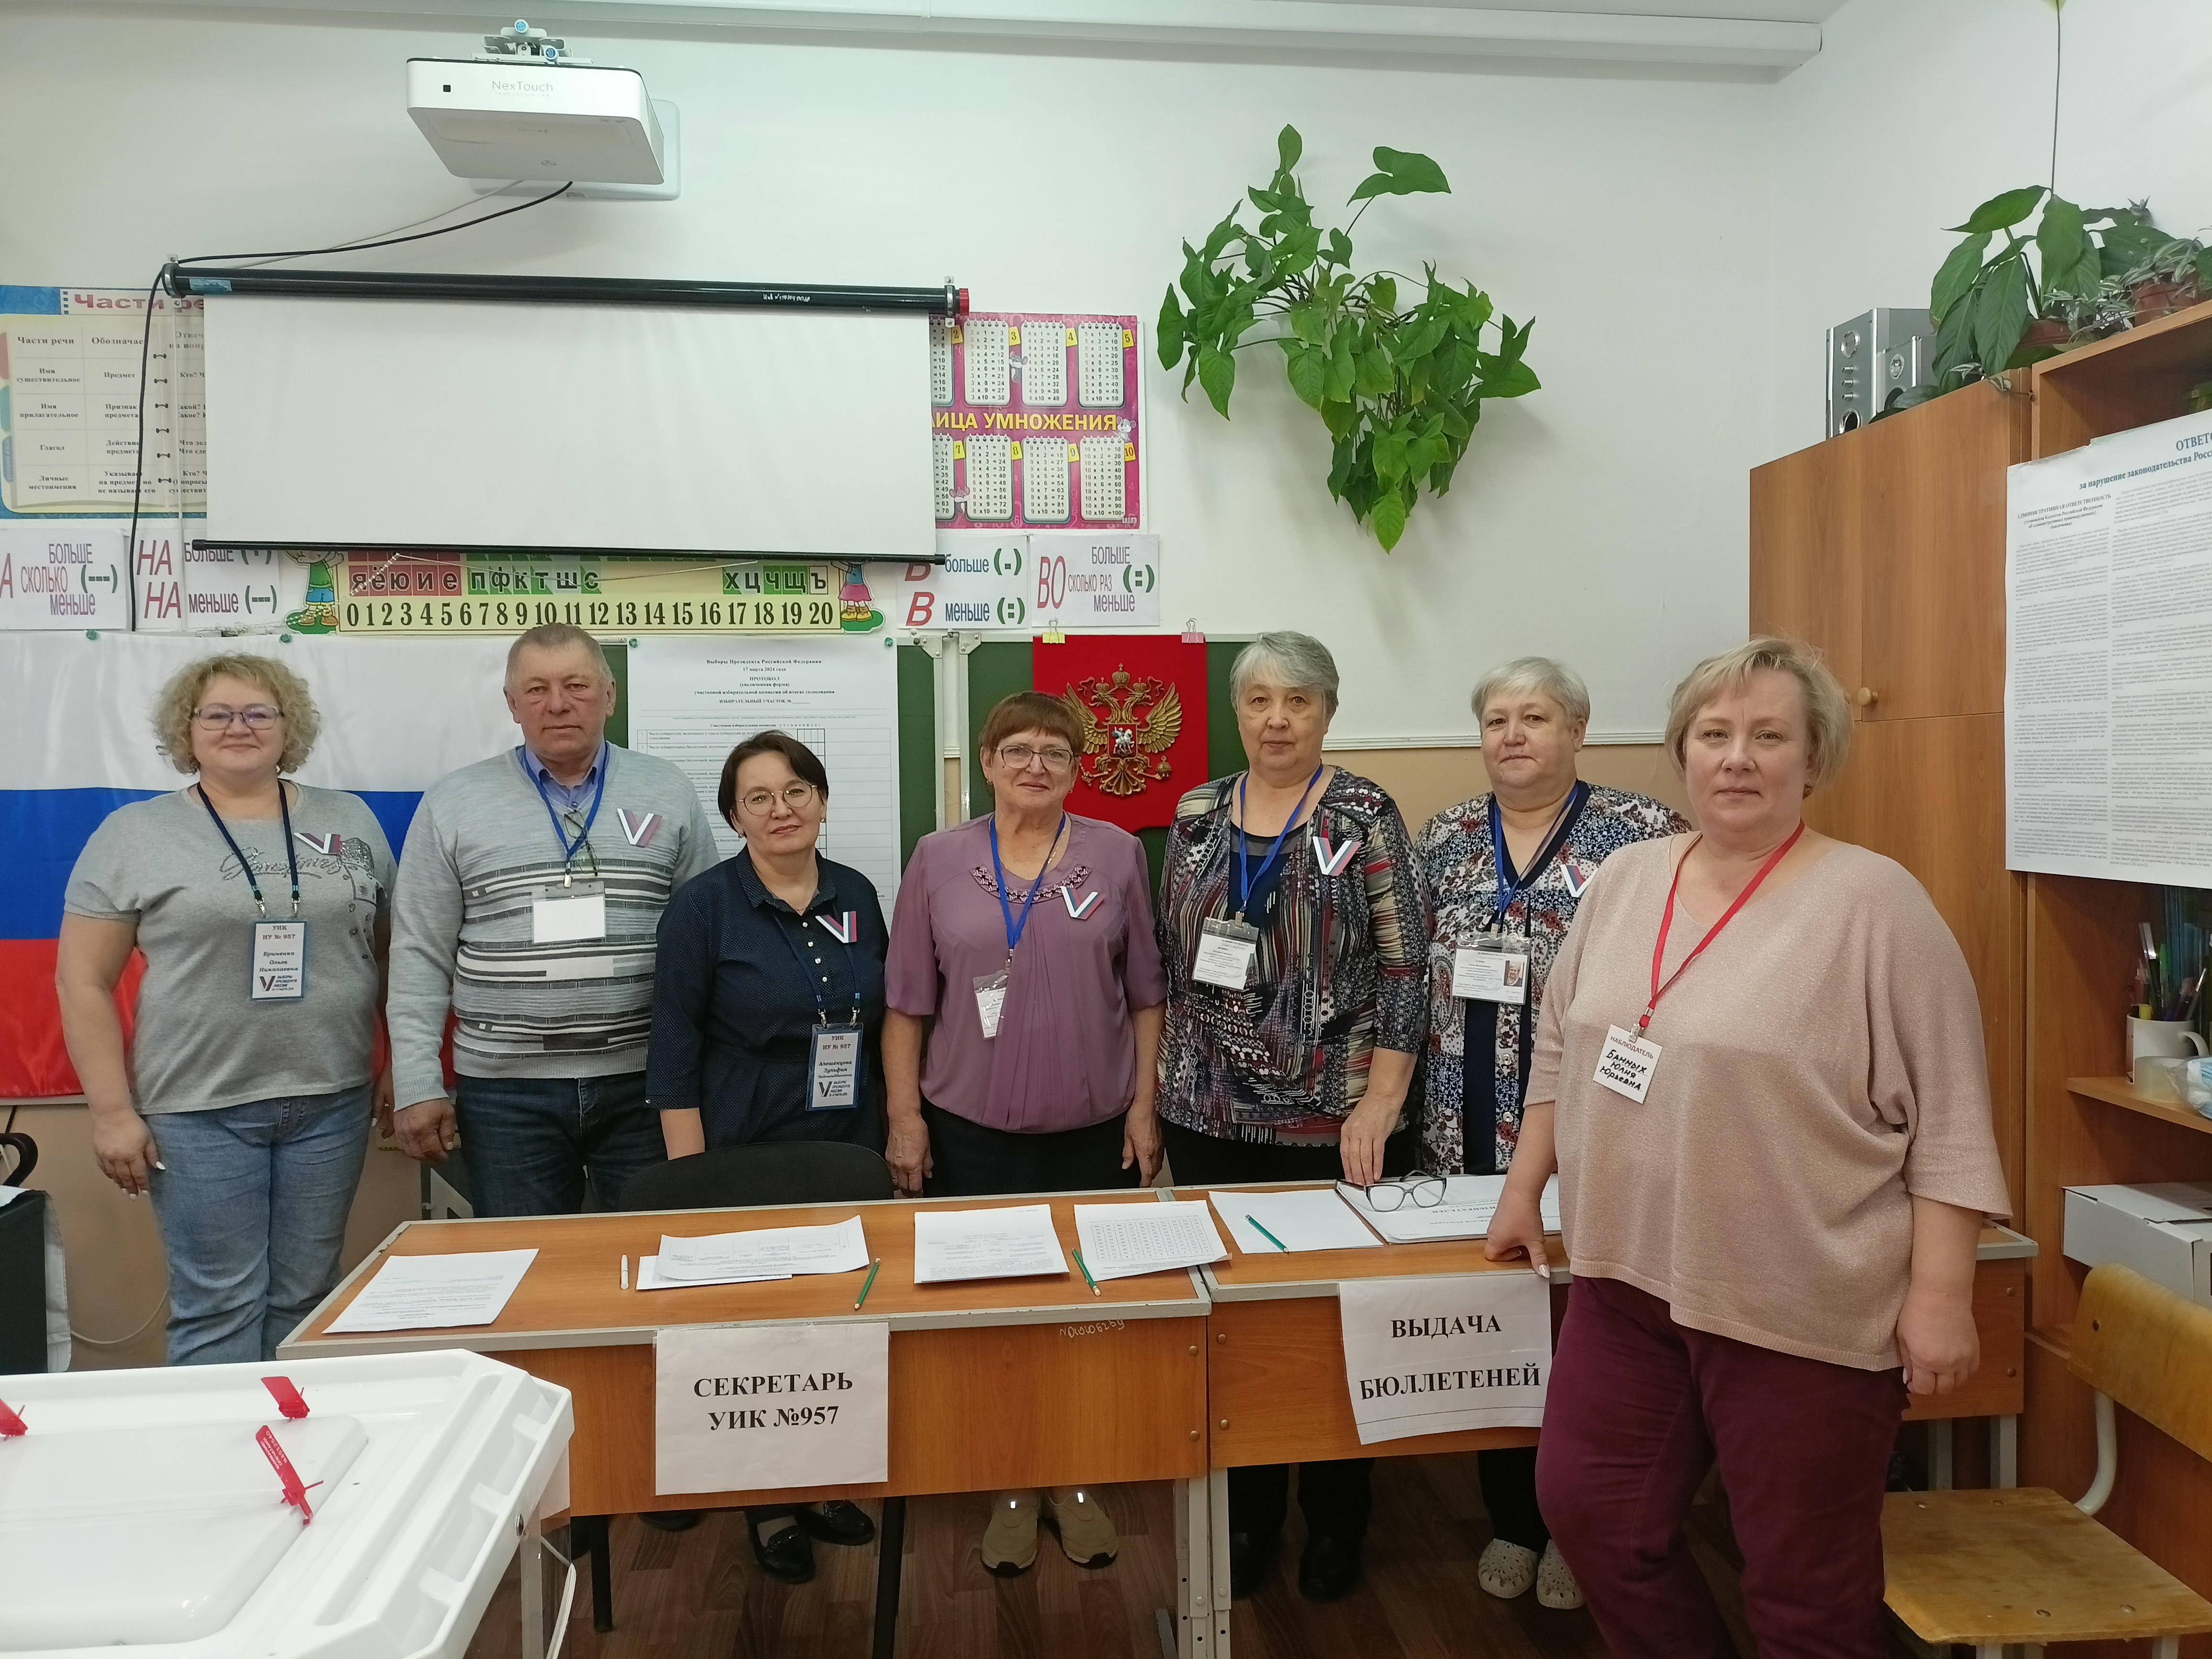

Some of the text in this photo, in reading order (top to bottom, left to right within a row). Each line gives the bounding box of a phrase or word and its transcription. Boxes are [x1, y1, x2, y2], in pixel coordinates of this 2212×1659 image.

[492, 80, 553, 92] NexTouch
[75, 294, 165, 310] Части
[18, 336, 75, 346] Части речи
[91, 337, 144, 345] Обозначае
[983, 413, 1117, 431] УМНОЖЕНИЯ
[2088, 473, 2126, 488] нарушение
[2127, 456, 2191, 478] законодательства
[2017, 493, 2112, 520] АДМИНИСТРАТИВНАЯ ОТВЕТСТВЕННОСТЬ
[49, 543, 93, 564] БОЛЬШЕ
[136, 540, 172, 575] НА
[1092, 546, 1130, 564] БОЛЬШЕ
[21, 566, 68, 593] СКОЛЬКО
[1037, 555, 1066, 609] ВО
[1068, 574, 1097, 593] СКОЛЬКО
[1100, 574, 1112, 592] РАЗ
[144, 582, 181, 619] НА
[906, 591, 935, 627] В
[347, 602, 833, 626] 0 1 2 3 4 5 6 7 8 9 10 11 12 13 14 15 16 17 18 19 20
[1610, 1036, 1654, 1059] НАБЛЮДАТЕЛЬ
[1391, 1315, 1502, 1340] ВЫДАЧА
[694, 1372, 853, 1397] СЕКРЕТАРЬ
[1359, 1362, 1541, 1400] БЮЛЛЕТЕНЕЙ
[708, 1405, 839, 1430] УИК №957
